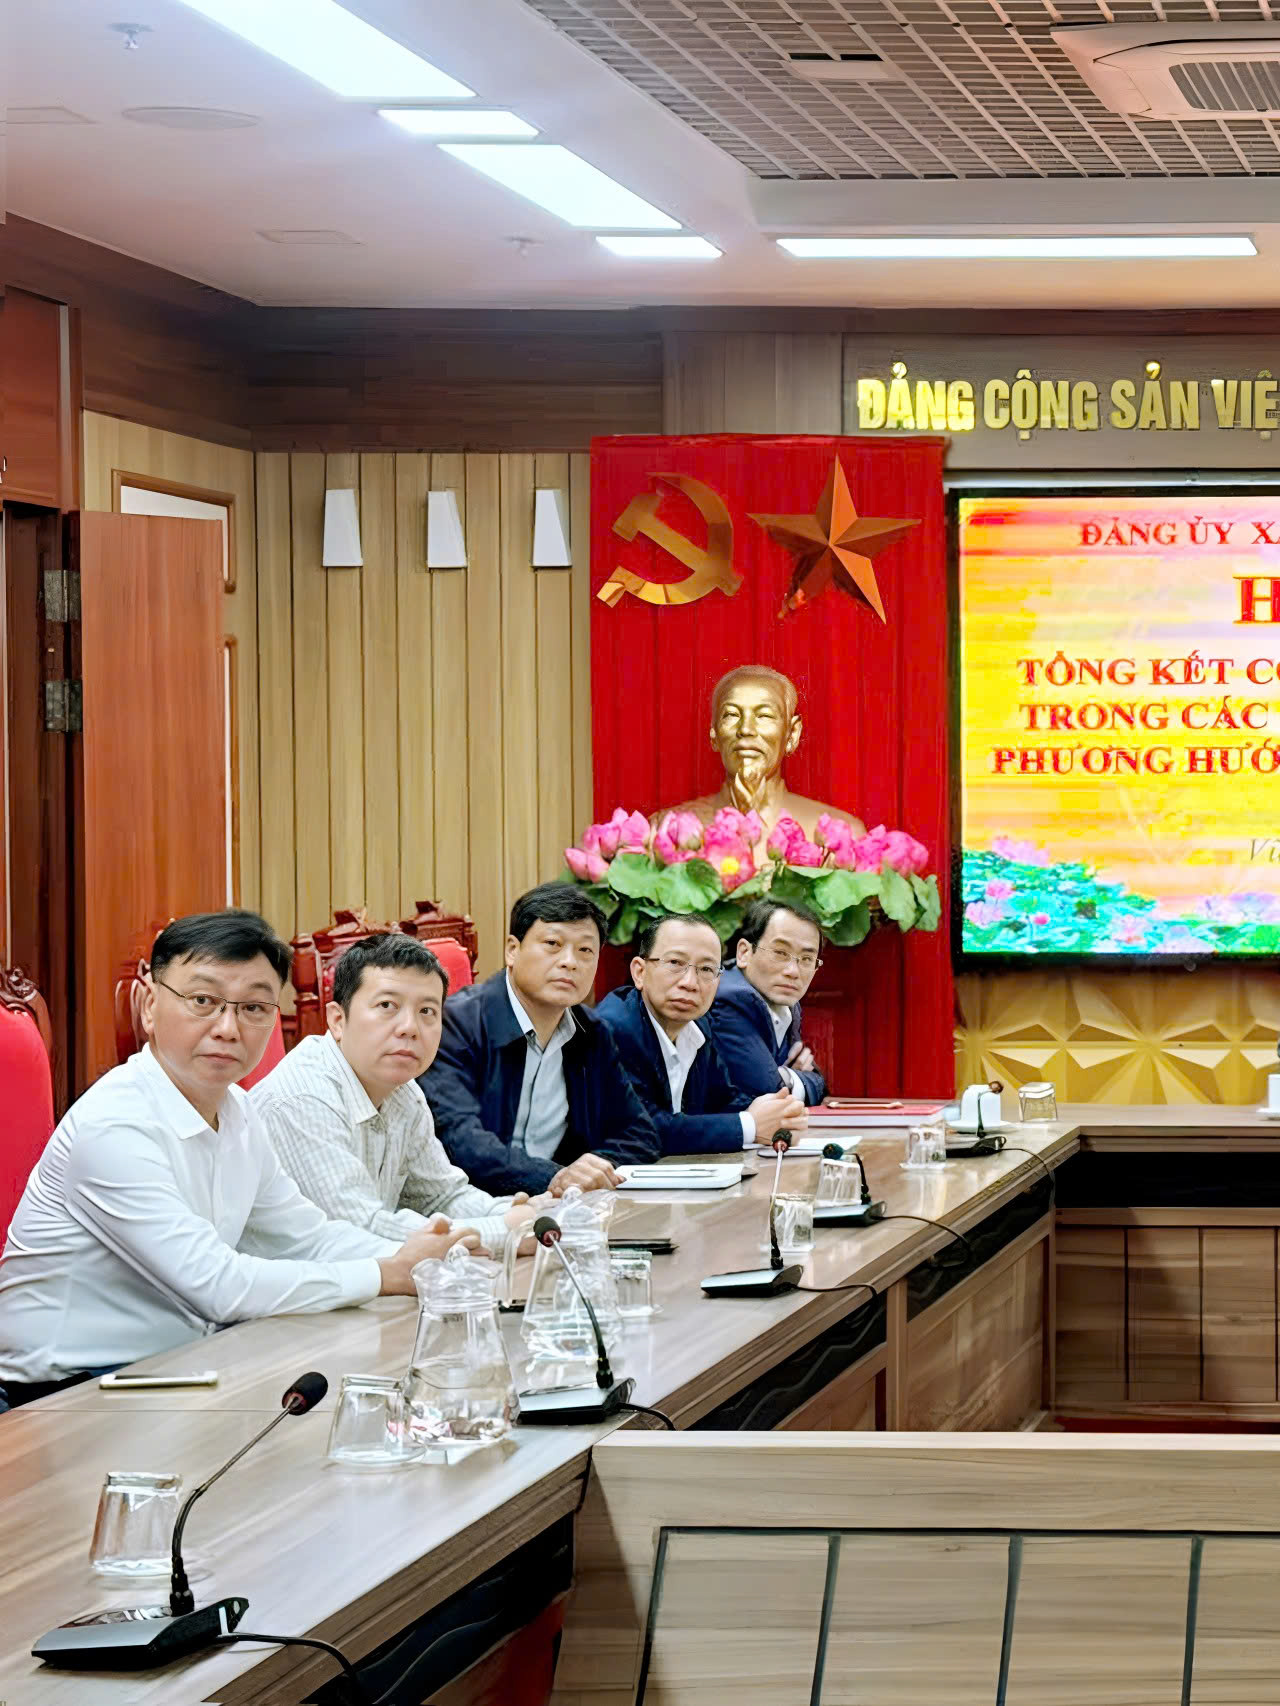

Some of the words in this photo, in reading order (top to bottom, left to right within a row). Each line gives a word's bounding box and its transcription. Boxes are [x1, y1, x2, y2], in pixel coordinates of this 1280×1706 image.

[857, 361, 975, 430] ĐẢNG
[983, 368, 1098, 440] CỘNG
[1110, 361, 1199, 430] SẢN
[1079, 516, 1178, 546] ĐẢNG
[1148, 649, 1234, 685] KẾT
[1019, 702, 1169, 731] TRONG
[1181, 695, 1269, 730] CÁC
[991, 743, 1175, 775] PHƯƠNG
